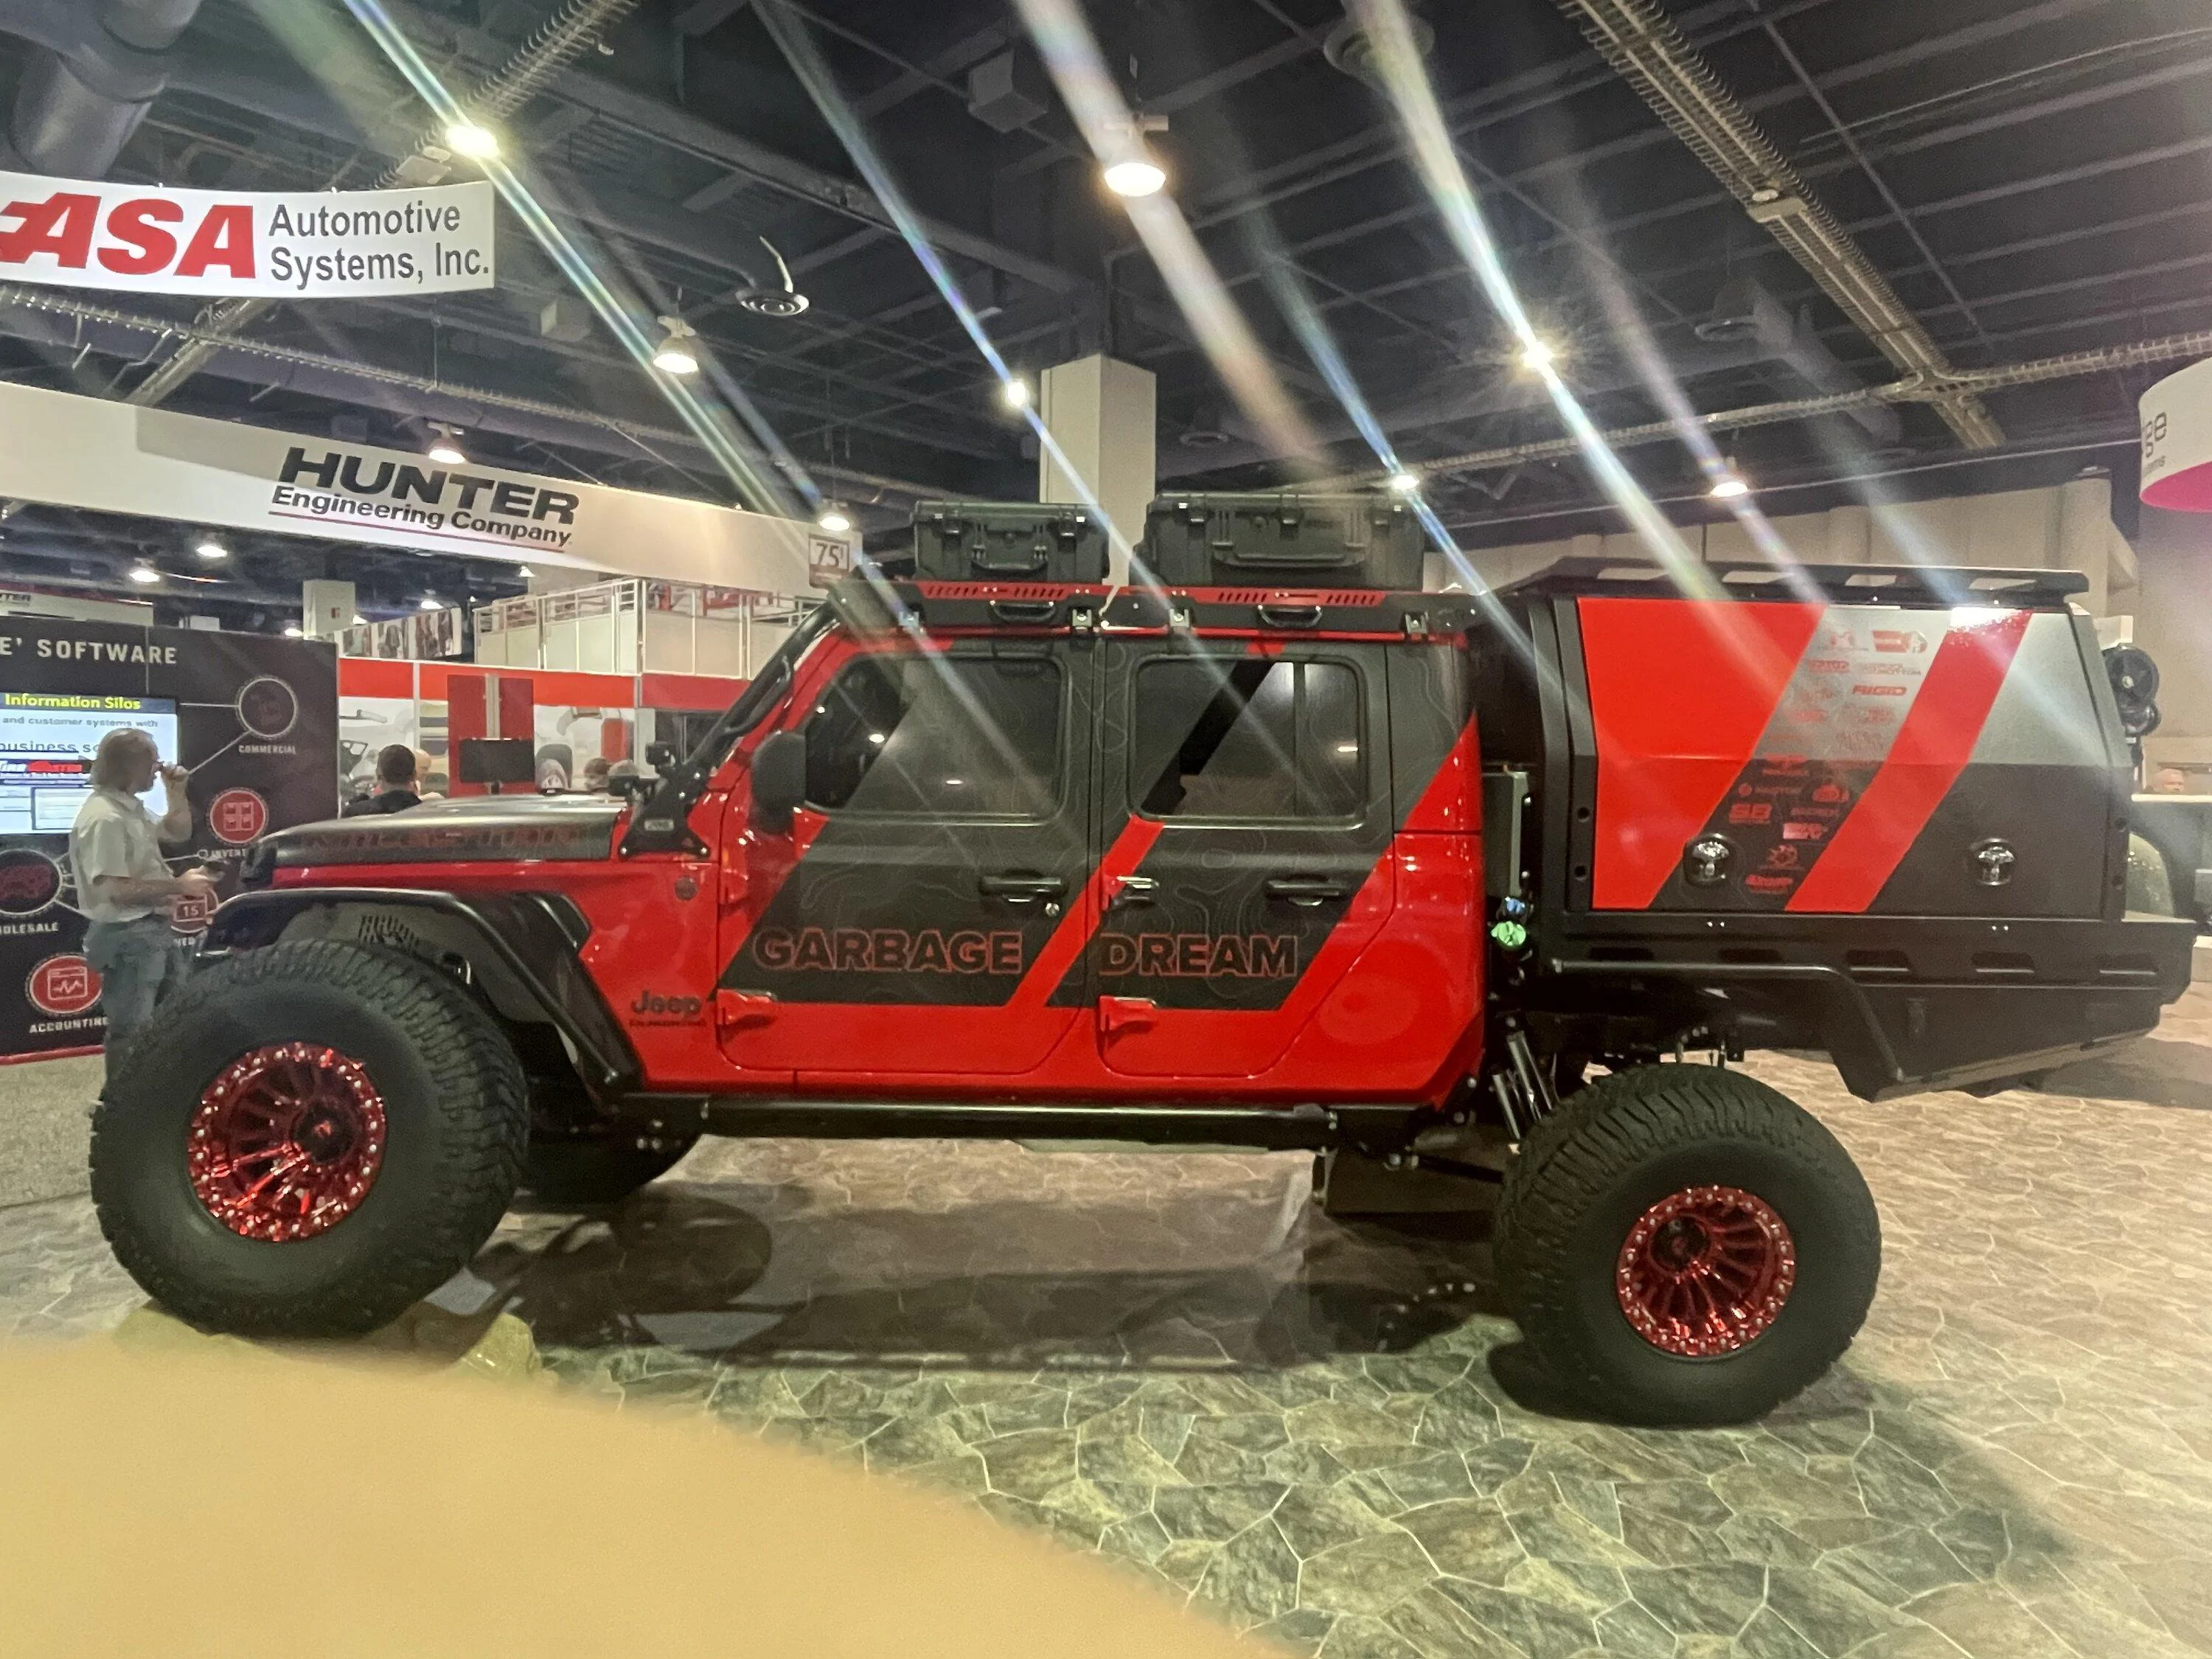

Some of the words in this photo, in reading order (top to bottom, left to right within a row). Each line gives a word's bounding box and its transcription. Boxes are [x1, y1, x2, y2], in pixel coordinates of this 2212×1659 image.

[268, 200, 461, 237] Automotive
[1, 192, 256, 279] ASA
[271, 246, 424, 290] Systems,
[435, 242, 489, 276] Inc.
[278, 447, 580, 525] HUNTER
[271, 485, 444, 530] Engineering
[451, 510, 572, 547] Company
[37, 639, 178, 664] SOFTWARE
[5, 693, 100, 709] Information
[105, 696, 141, 710] Silos
[3, 716, 24, 724] and
[28, 717, 83, 726] customer
[86, 718, 133, 728] systems
[135, 720, 159, 728] with
[238, 745, 296, 754] COMMERCIAL
[183, 905, 199, 917] 15
[0, 922, 59, 935] OLESALE
[752, 928, 1023, 975] GARBAGE
[1099, 933, 1298, 977] DREAM
[630, 989, 701, 1015] Jeep
